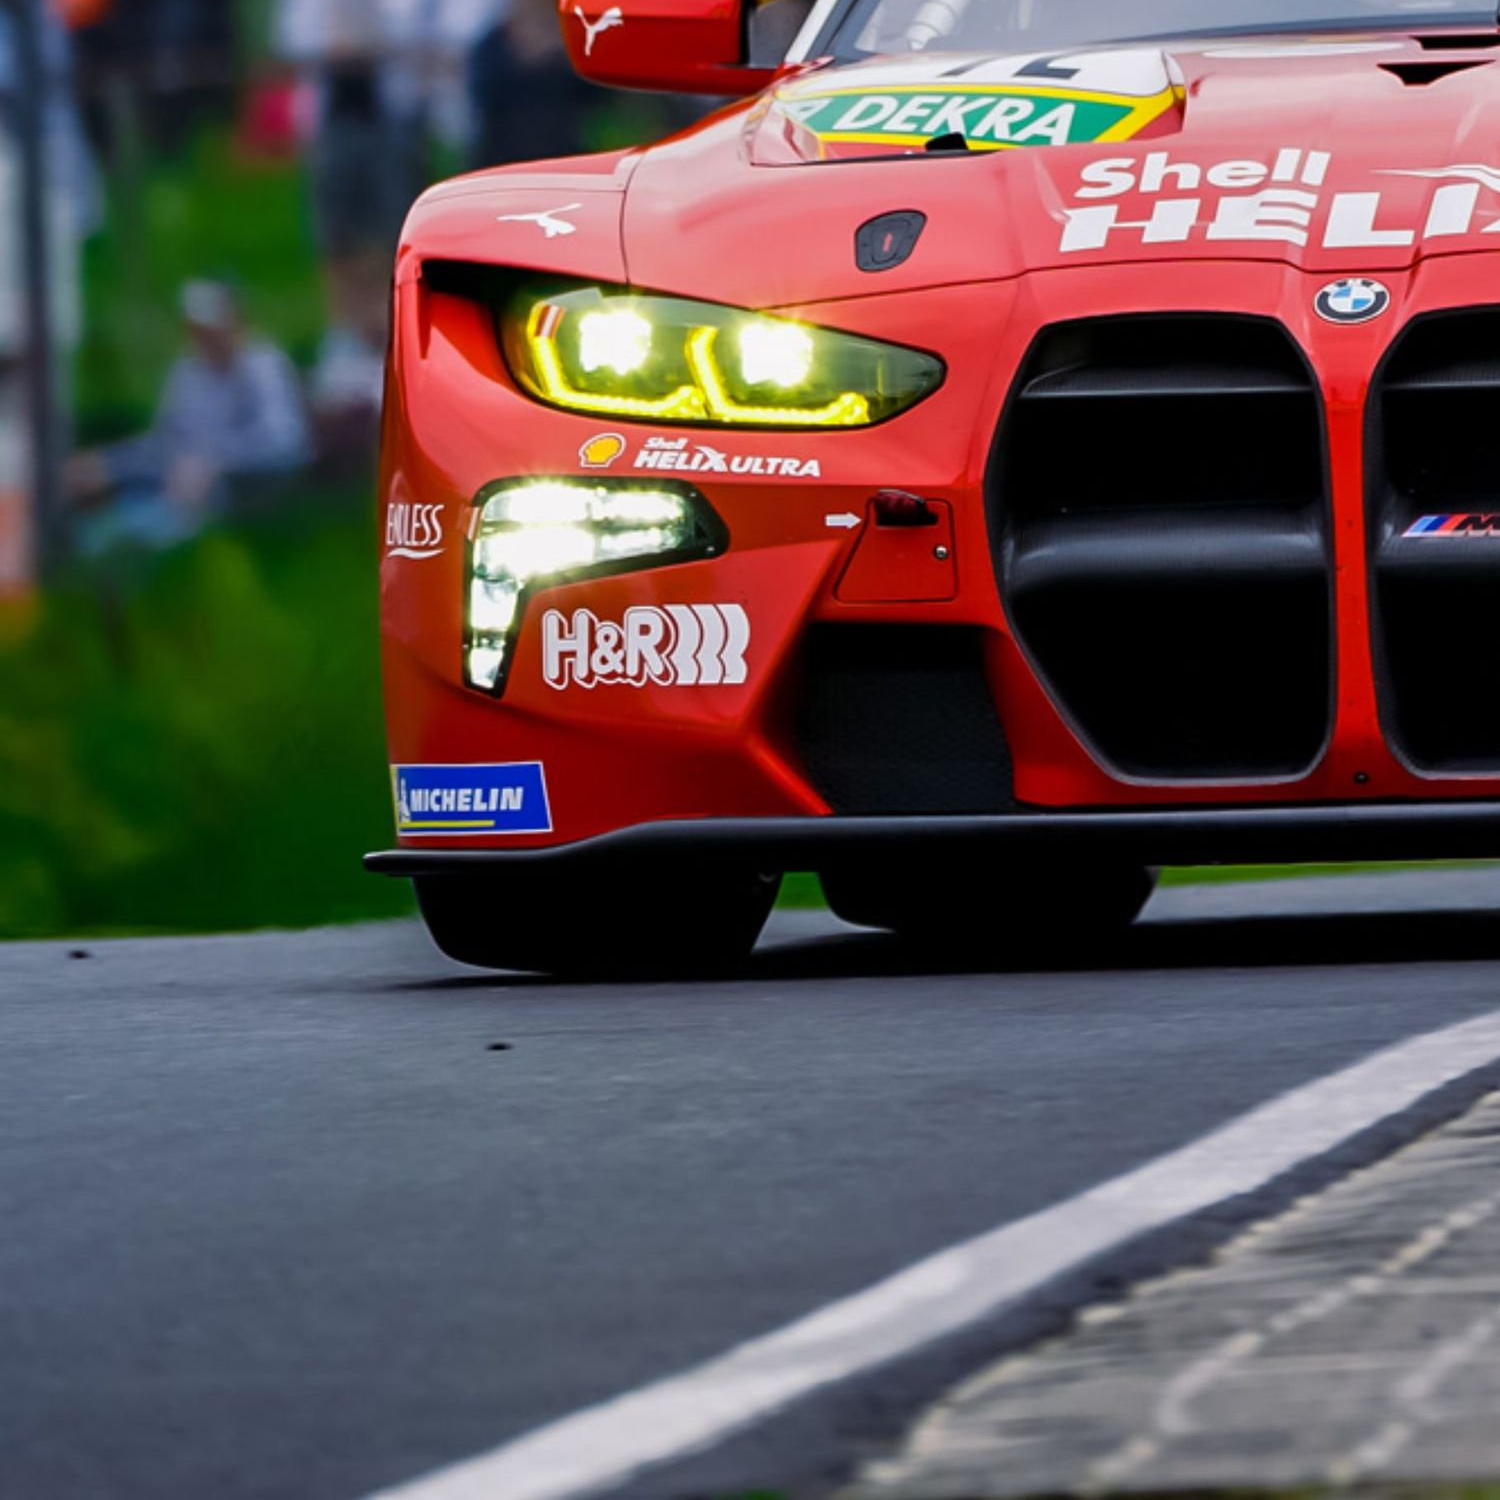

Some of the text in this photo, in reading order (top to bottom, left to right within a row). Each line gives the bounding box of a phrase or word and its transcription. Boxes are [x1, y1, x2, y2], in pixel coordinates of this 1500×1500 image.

[832, 95, 1075, 147] DEKRA
[1074, 147, 1331, 199] Shell
[633, 445, 821, 477] HELIX ULTRA
[644, 437, 689, 450] Shell
[543, 606, 677, 690] H&R
[410, 786, 524, 812] MICHELIN
